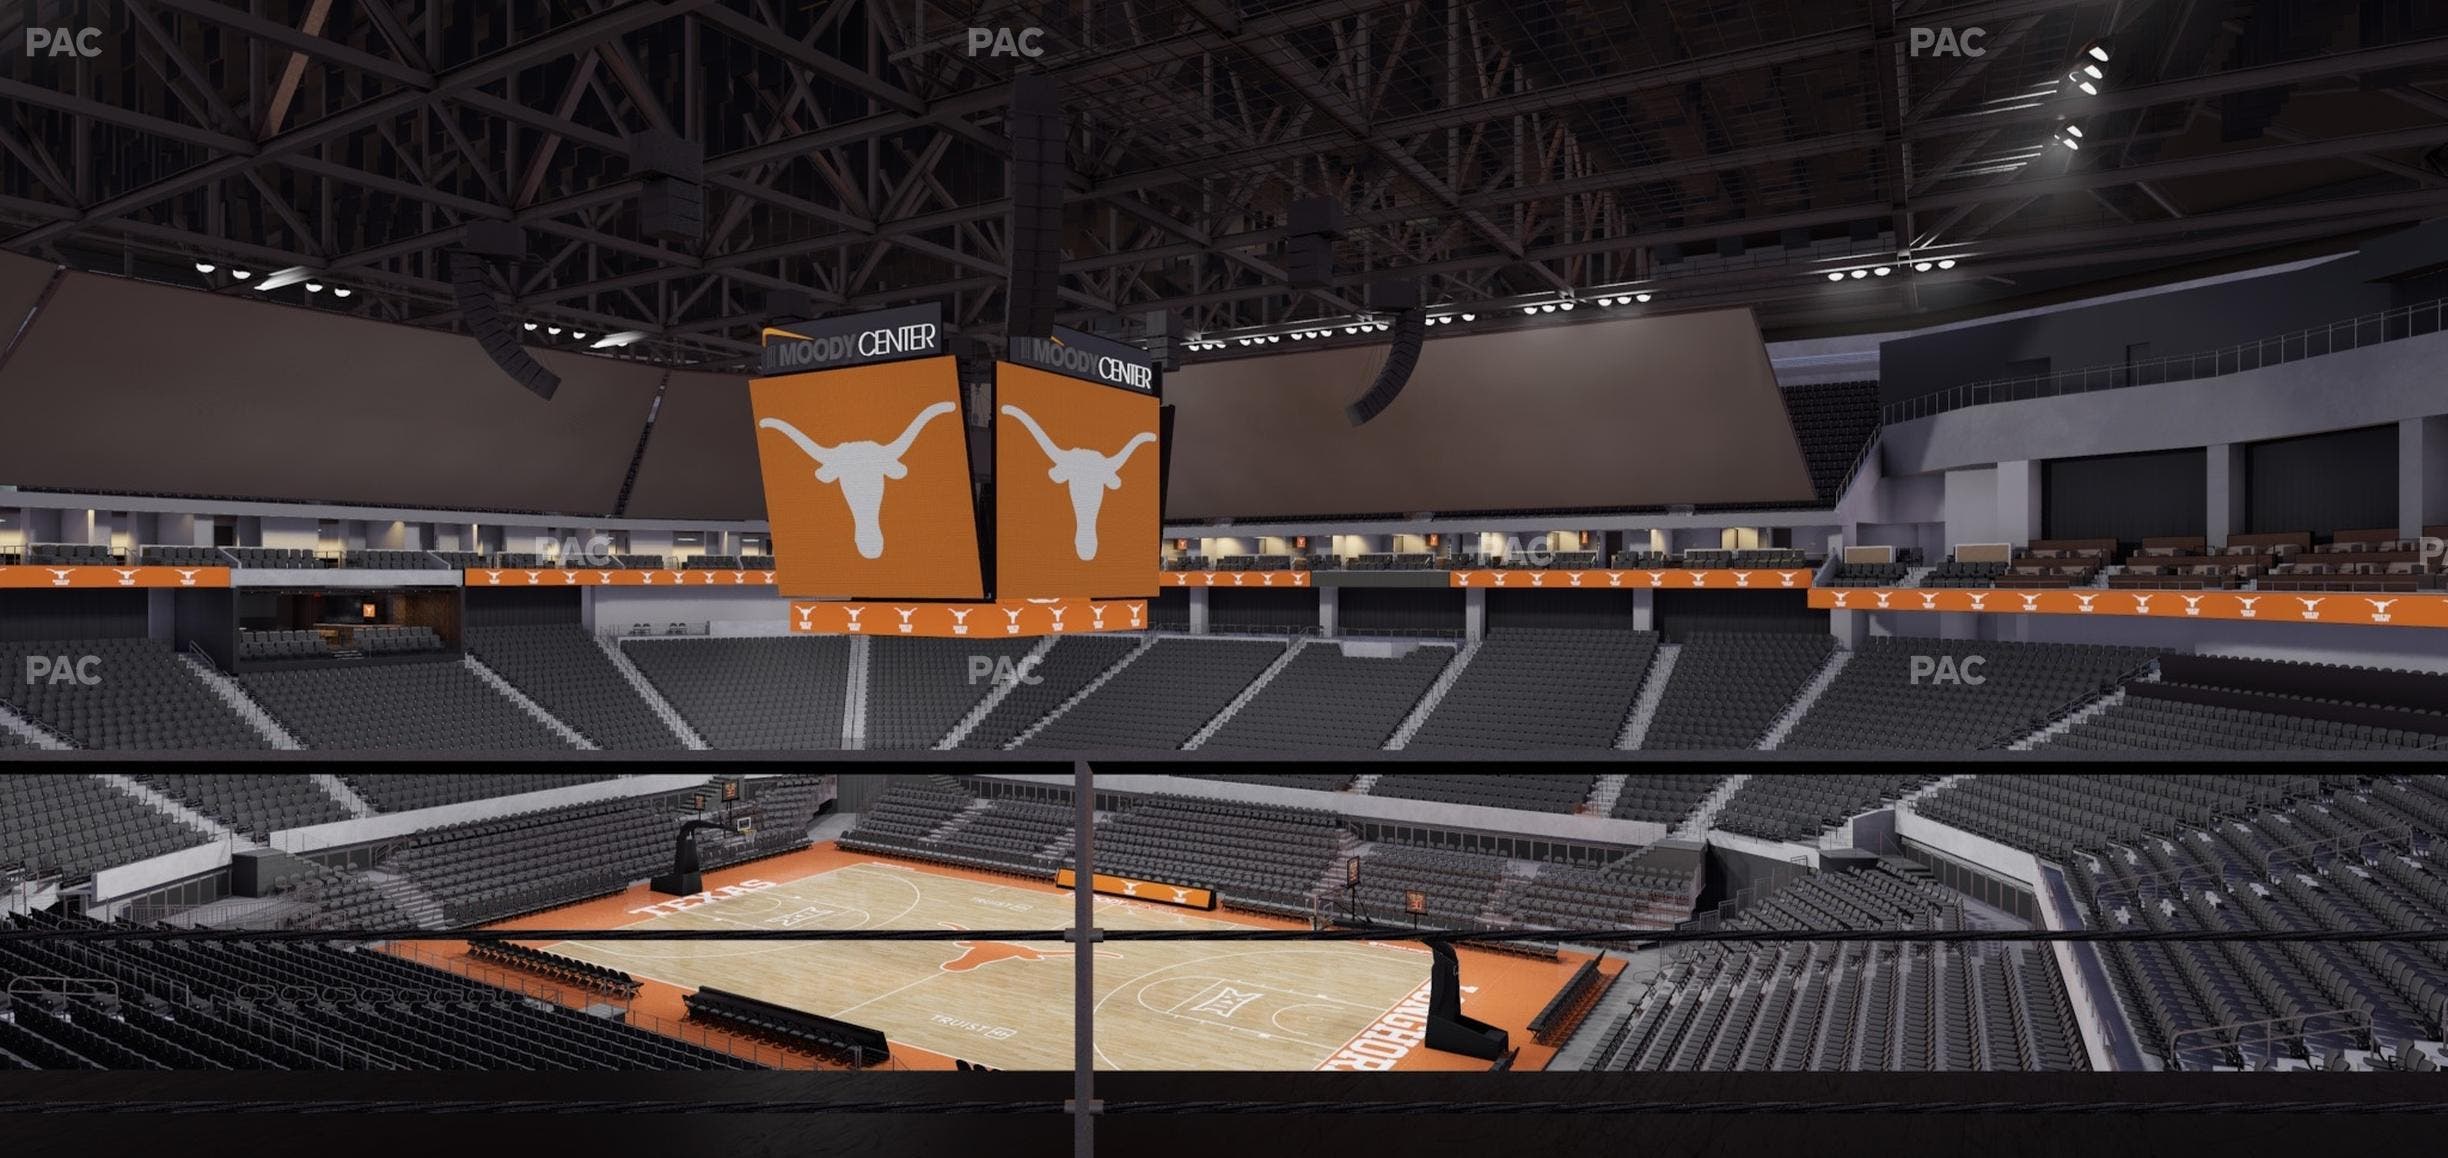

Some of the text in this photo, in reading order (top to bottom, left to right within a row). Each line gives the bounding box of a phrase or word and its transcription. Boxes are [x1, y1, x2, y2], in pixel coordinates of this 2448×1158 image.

[779, 323, 936, 366] MOODY CENTER
[1034, 337, 1152, 389] MOODY CENTER
[628, 878, 777, 918] TEXAS
[931, 1013, 991, 1033] TRUIST
